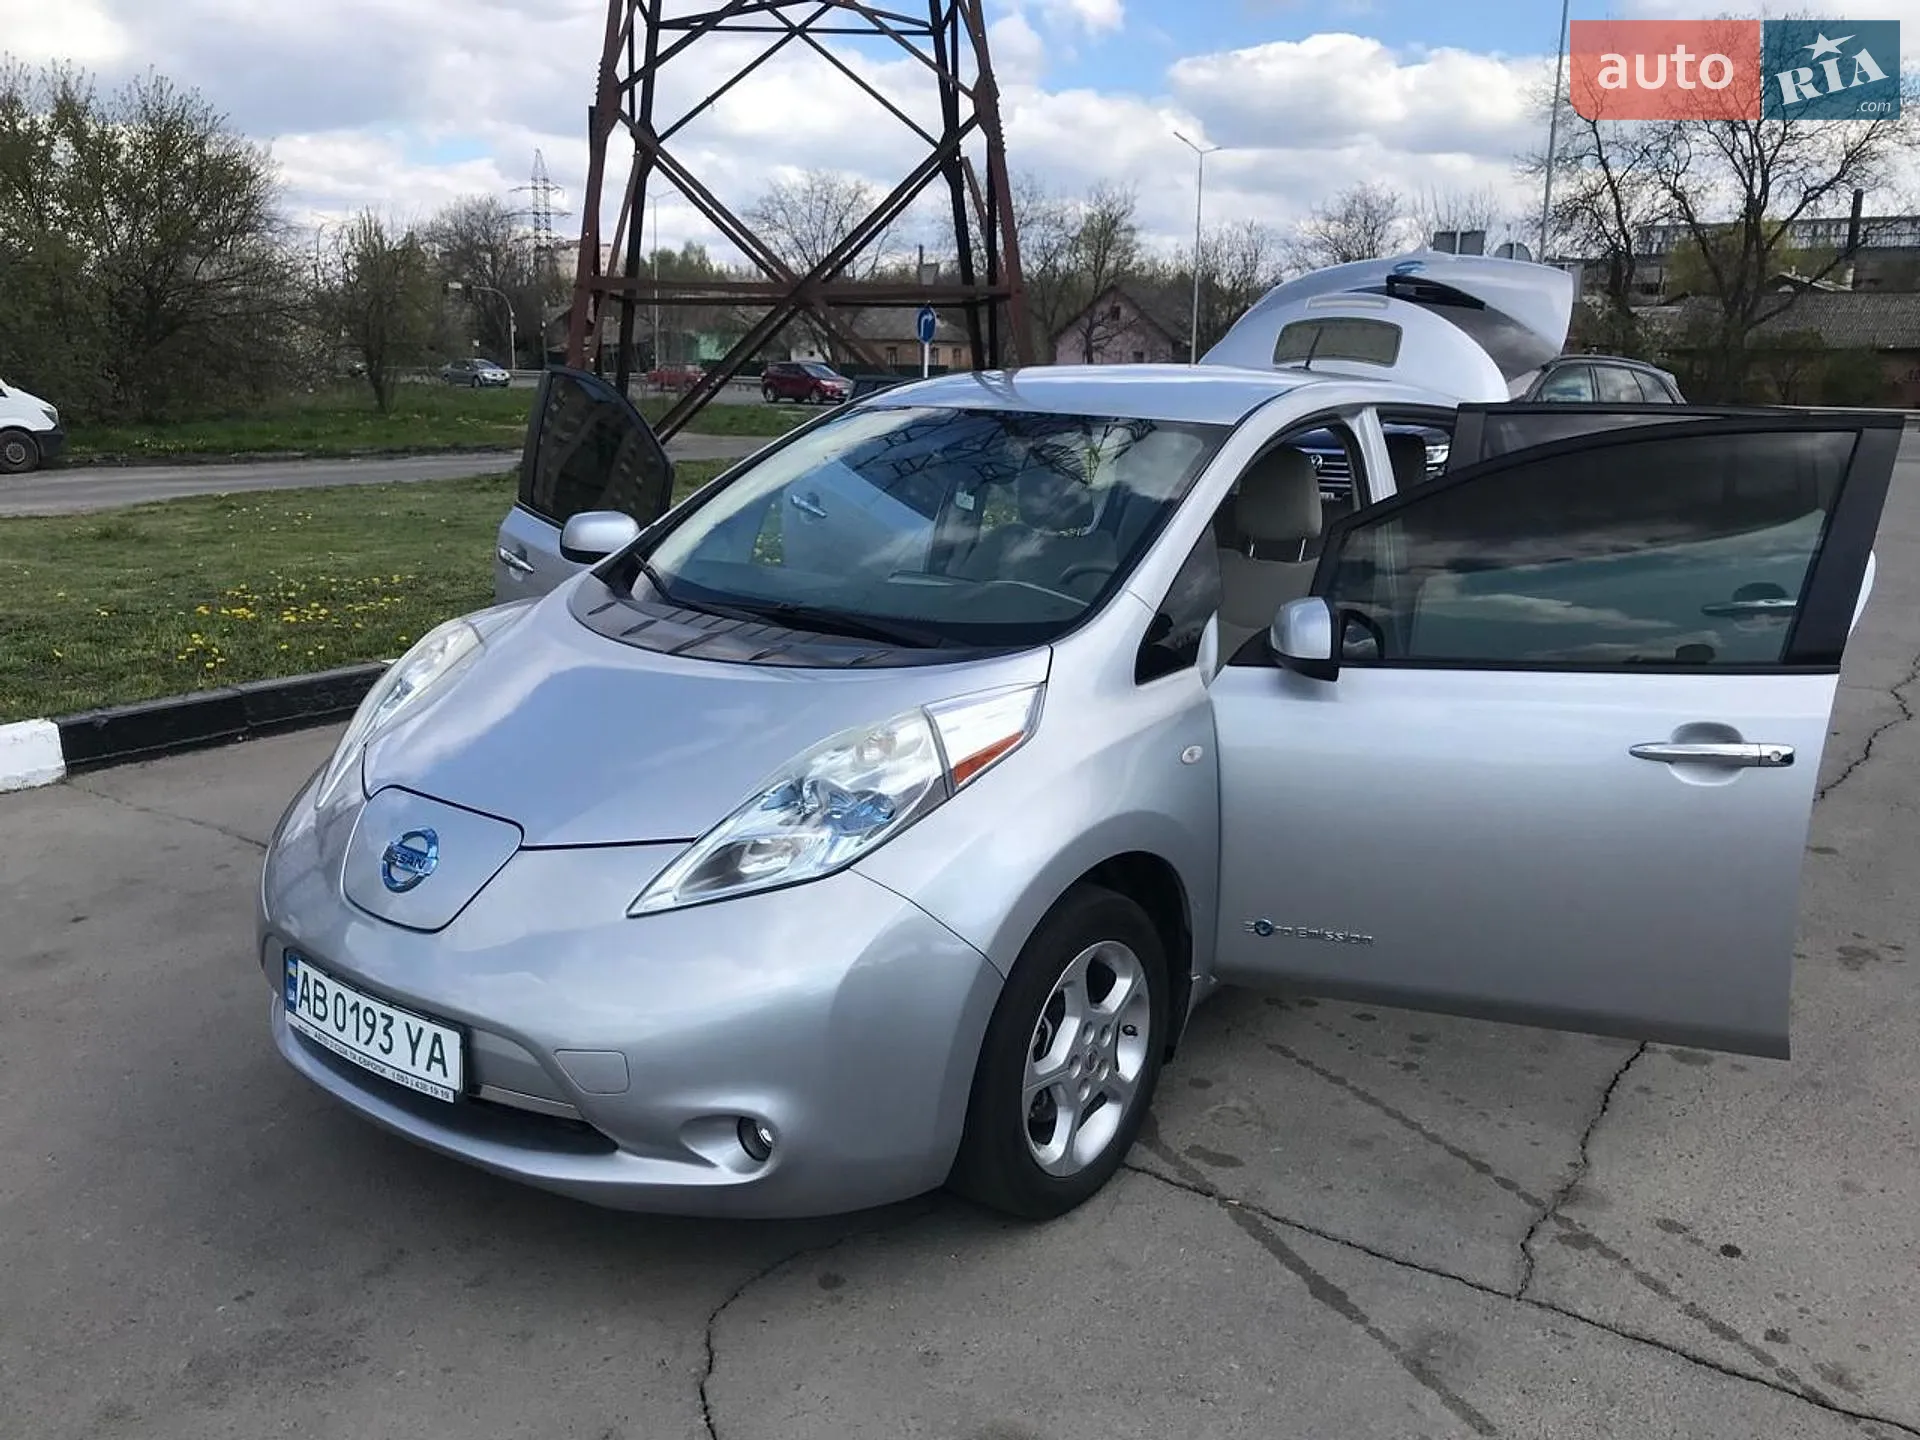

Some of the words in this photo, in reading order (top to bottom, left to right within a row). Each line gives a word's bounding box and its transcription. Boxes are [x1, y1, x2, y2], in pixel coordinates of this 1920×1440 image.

[298, 971, 329, 1023] AB
[332, 991, 394, 1056] 0193
[404, 1021, 448, 1078] YA
